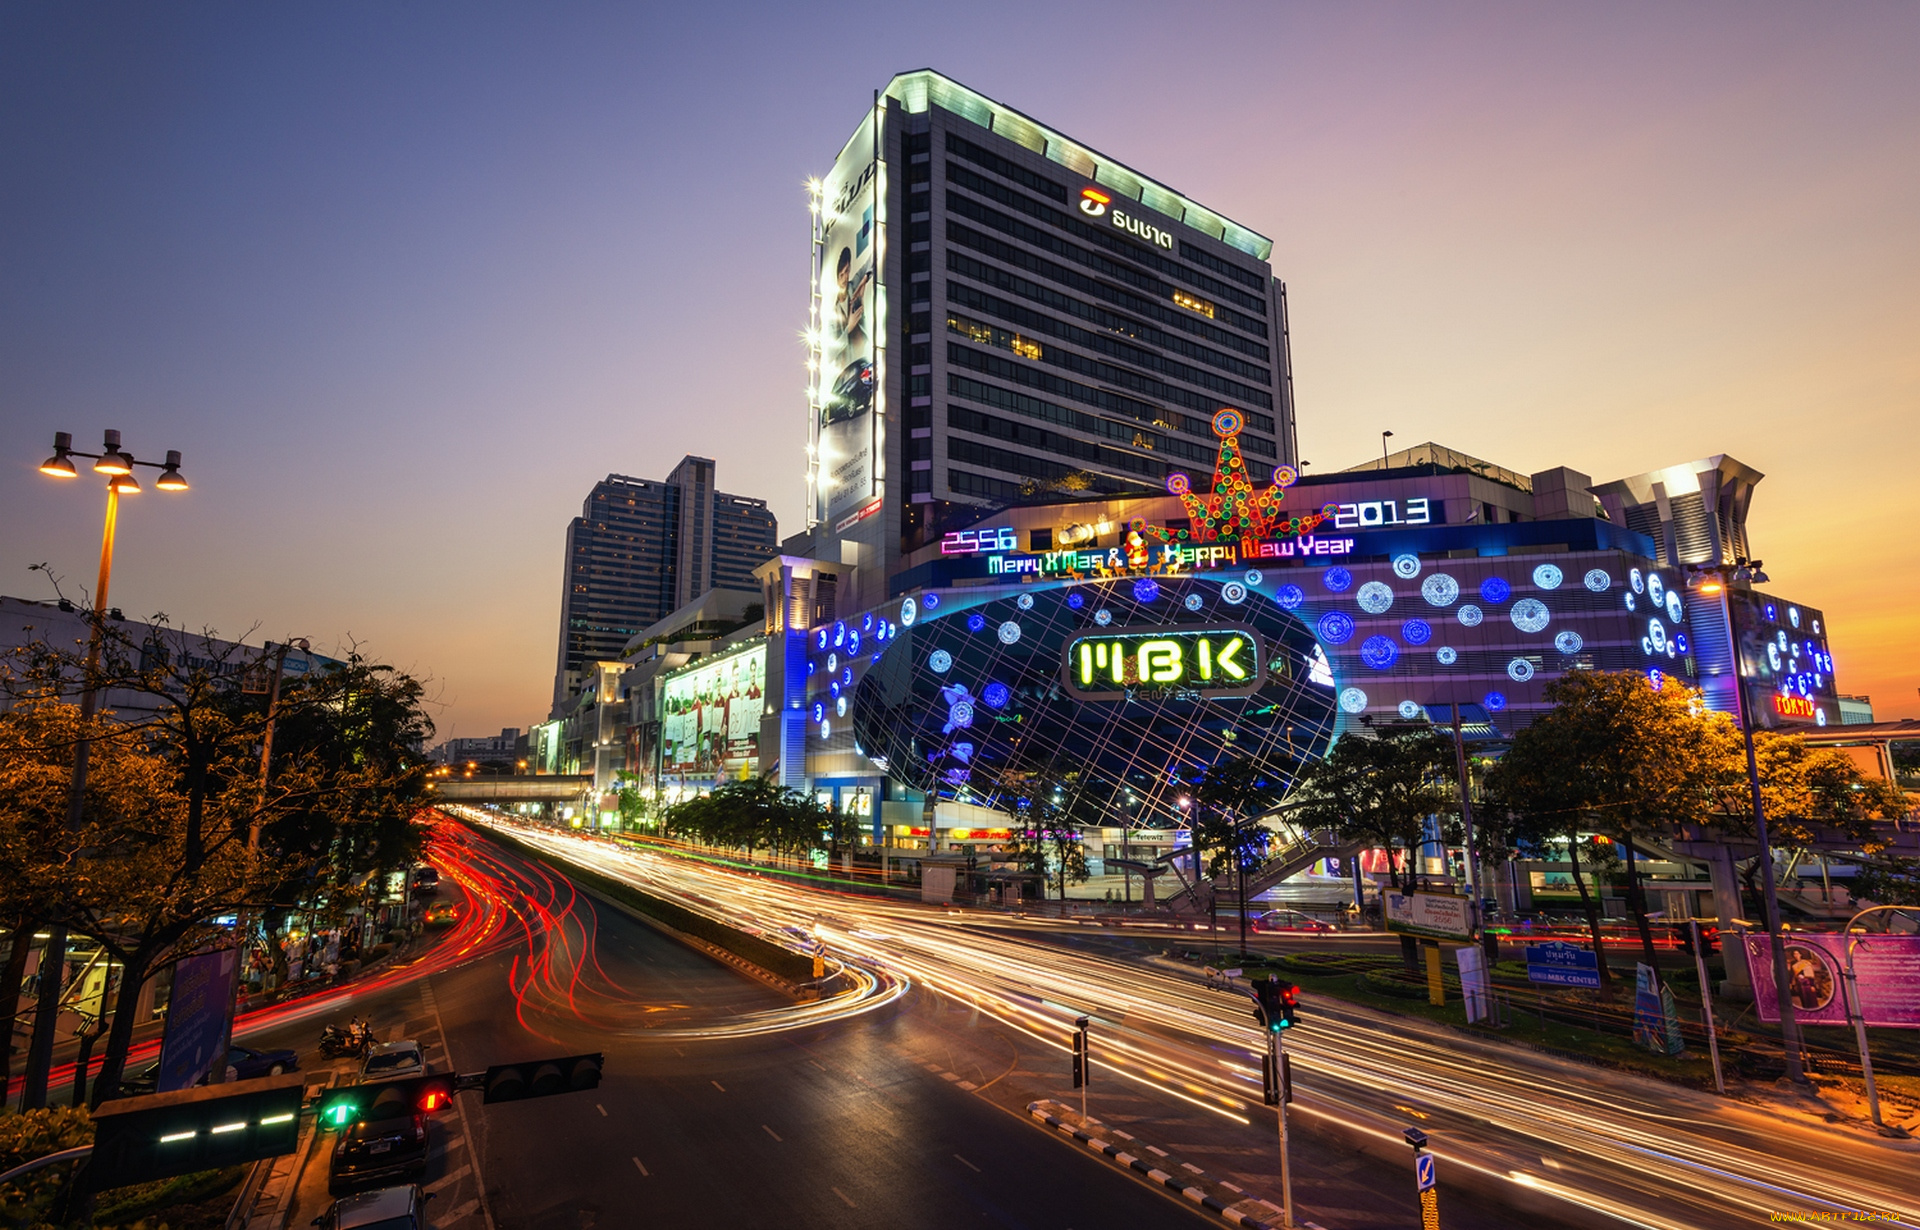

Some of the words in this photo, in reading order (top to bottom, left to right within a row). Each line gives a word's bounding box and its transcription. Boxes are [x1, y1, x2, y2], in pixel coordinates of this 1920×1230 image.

[1112, 209, 1172, 249] ธนชาต
[1335, 498, 1430, 528] 2013
[942, 527, 1017, 554] 2556
[989, 555, 1043, 577] Merry
[1045, 549, 1103, 571] X'Mas
[1164, 543, 1237, 567] Happy
[1241, 537, 1295, 559] New
[1297, 535, 1354, 557] Year
[1080, 637, 1245, 684] MBK
[1774, 696, 1814, 716] TOKYU
[1545, 950, 1576, 961] ปทุมวัน
[1547, 973, 1566, 982] MBK
[1567, 975, 1598, 985] CENTER
